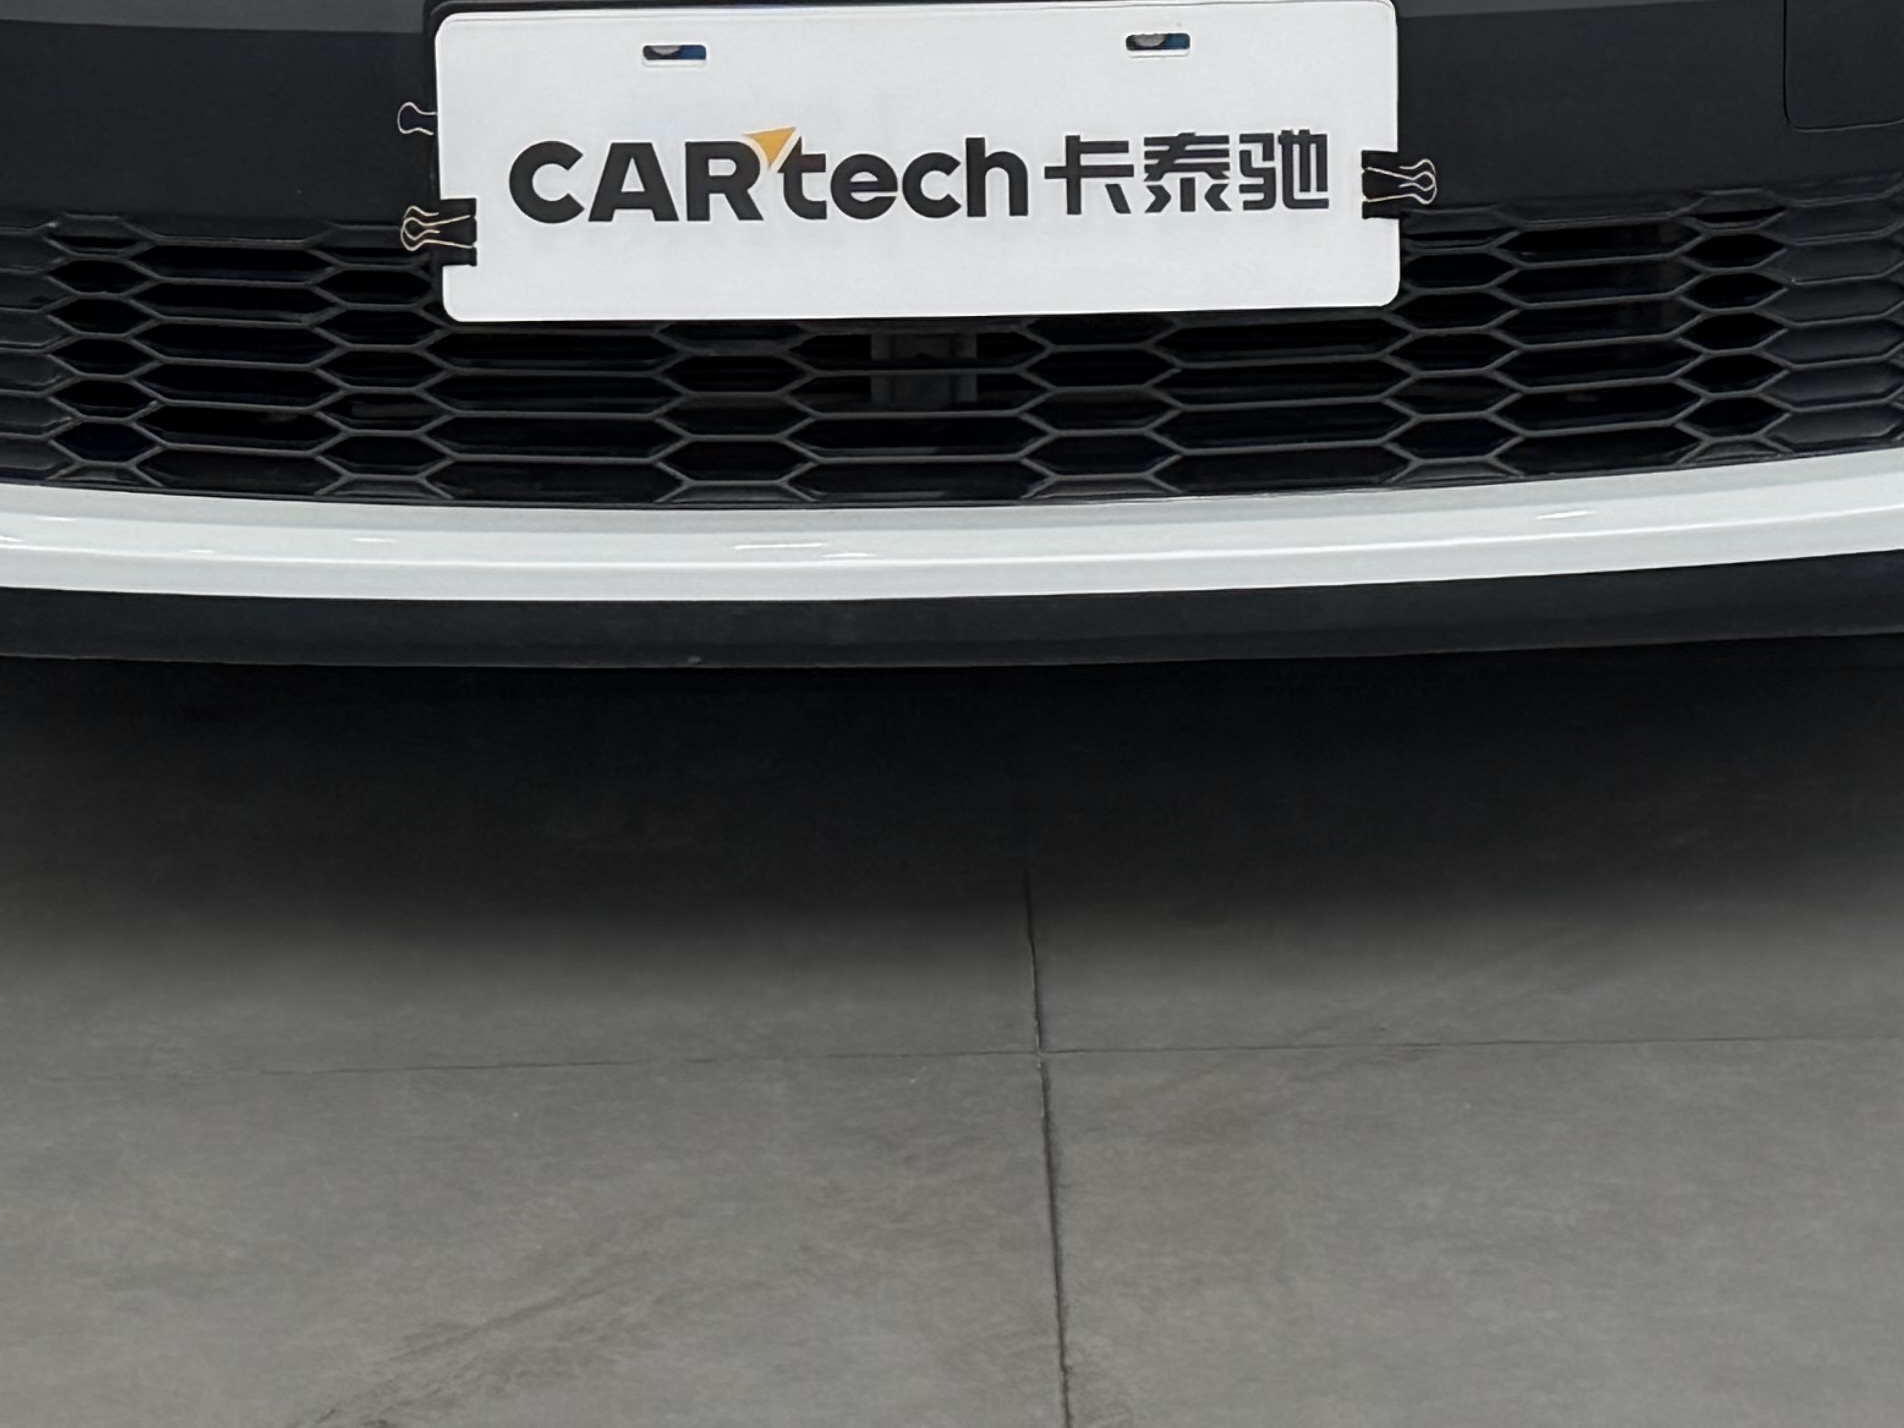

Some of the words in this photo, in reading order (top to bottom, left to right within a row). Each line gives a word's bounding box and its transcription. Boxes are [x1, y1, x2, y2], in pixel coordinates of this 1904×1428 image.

[507, 134, 1031, 226] CARtech
[1042, 129, 1331, 216] 卡泰驰
